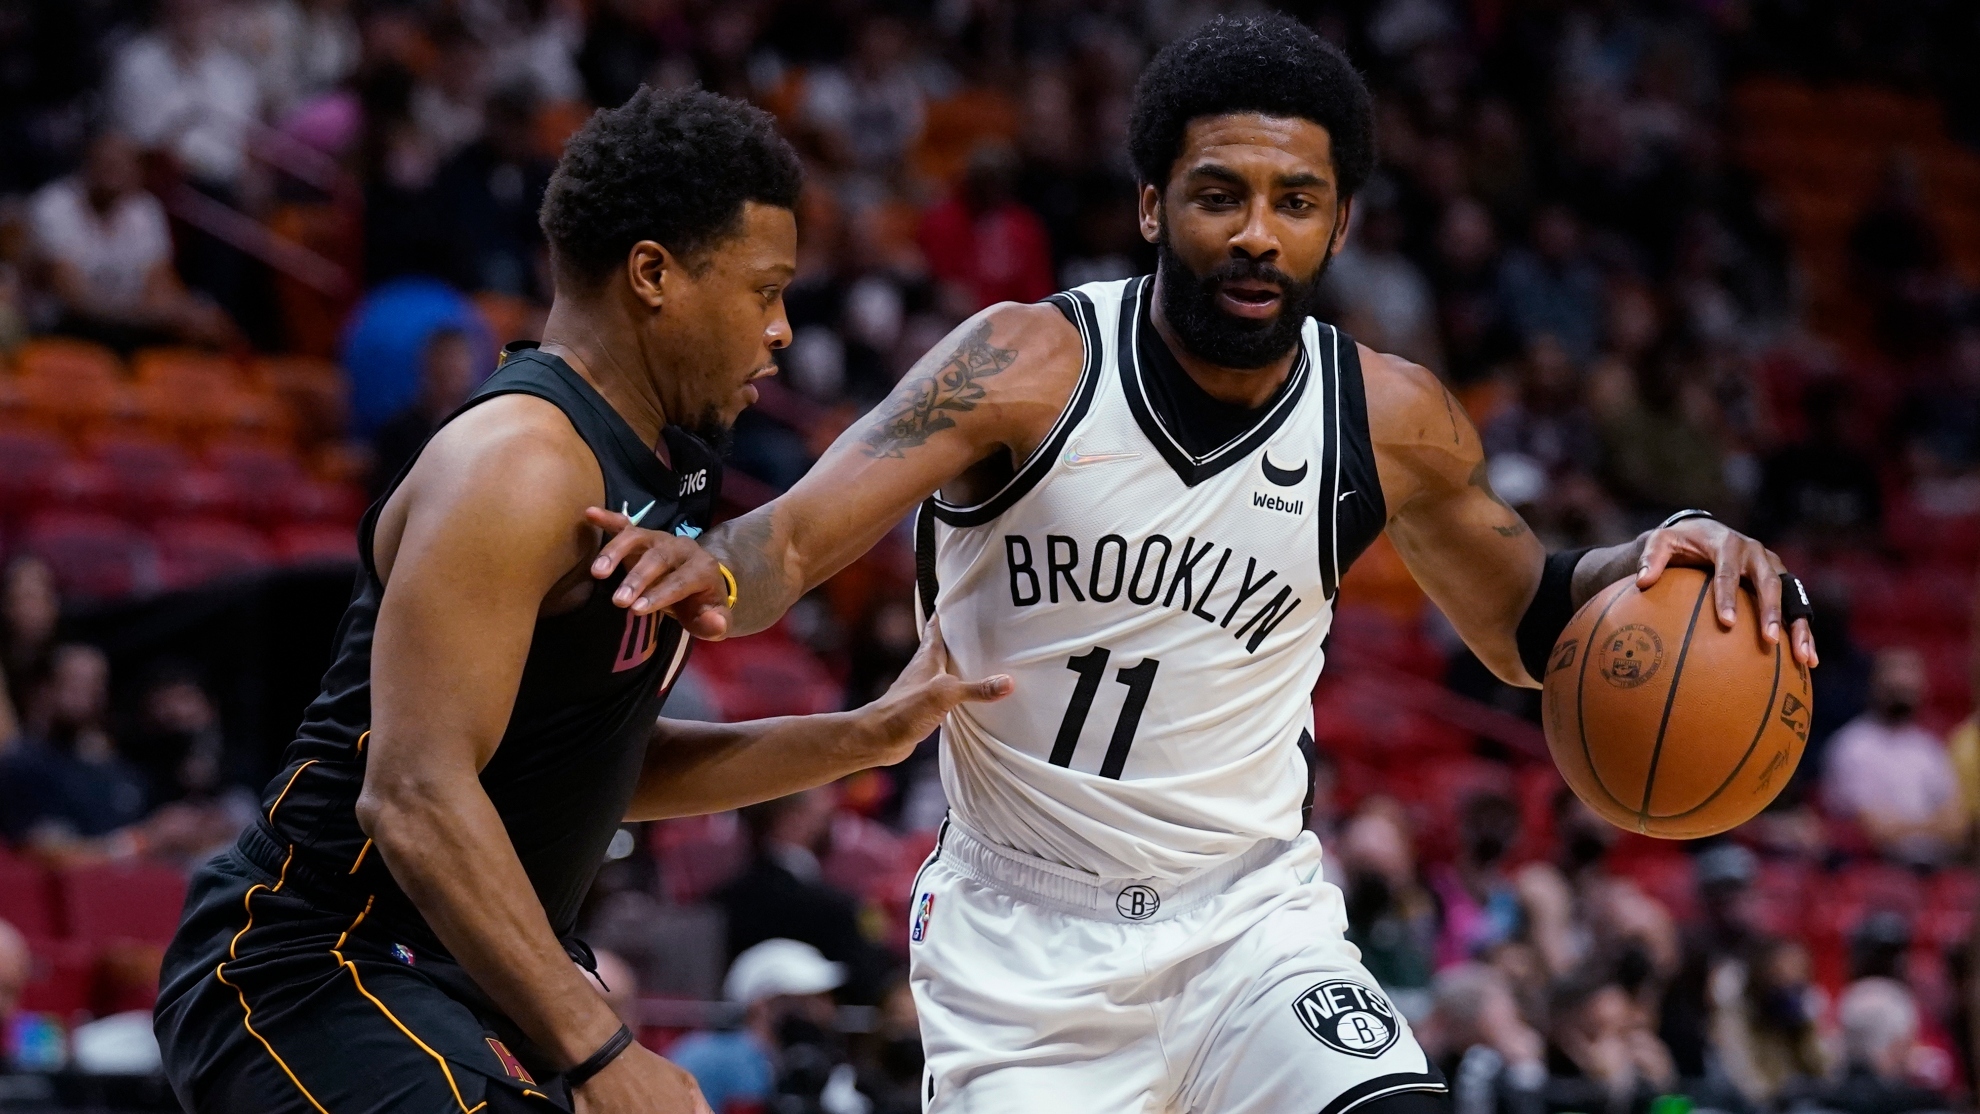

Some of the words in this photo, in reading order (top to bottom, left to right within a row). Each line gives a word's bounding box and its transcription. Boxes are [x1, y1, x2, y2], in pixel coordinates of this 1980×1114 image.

[1253, 491, 1304, 516] Webull
[1004, 533, 1302, 655] BROOKLYN
[1048, 645, 1160, 781] 11
[1131, 891, 1145, 916] B
[1302, 983, 1393, 1029] NETS
[1352, 1017, 1376, 1044] B
